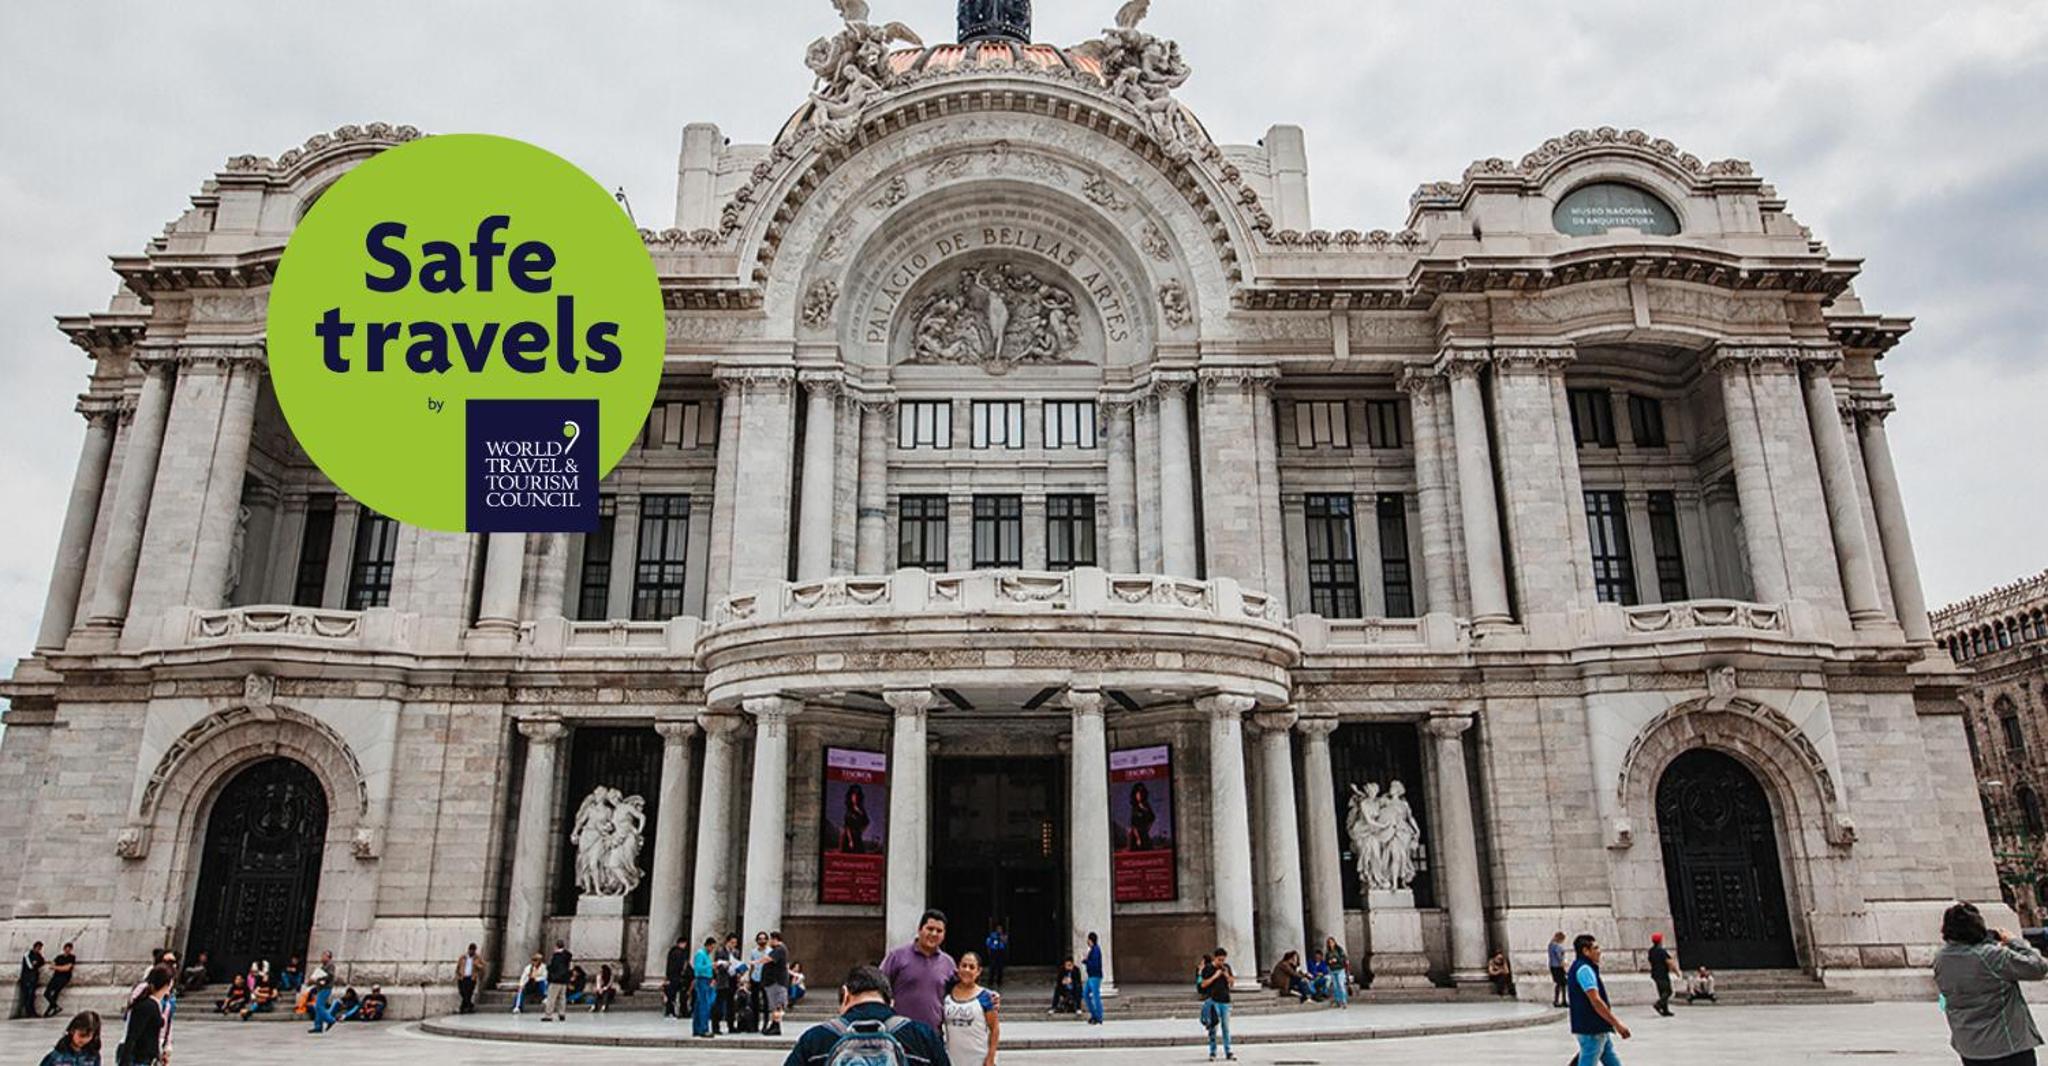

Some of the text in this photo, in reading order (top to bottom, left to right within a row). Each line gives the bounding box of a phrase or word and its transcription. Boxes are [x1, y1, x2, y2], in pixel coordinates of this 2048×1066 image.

[1571, 207, 1654, 216] MUSEO NACIONAL
[1586, 217, 1656, 226] ARQUITECTURA
[867, 227, 1129, 344] PALACIO DE BELLAS ARTES
